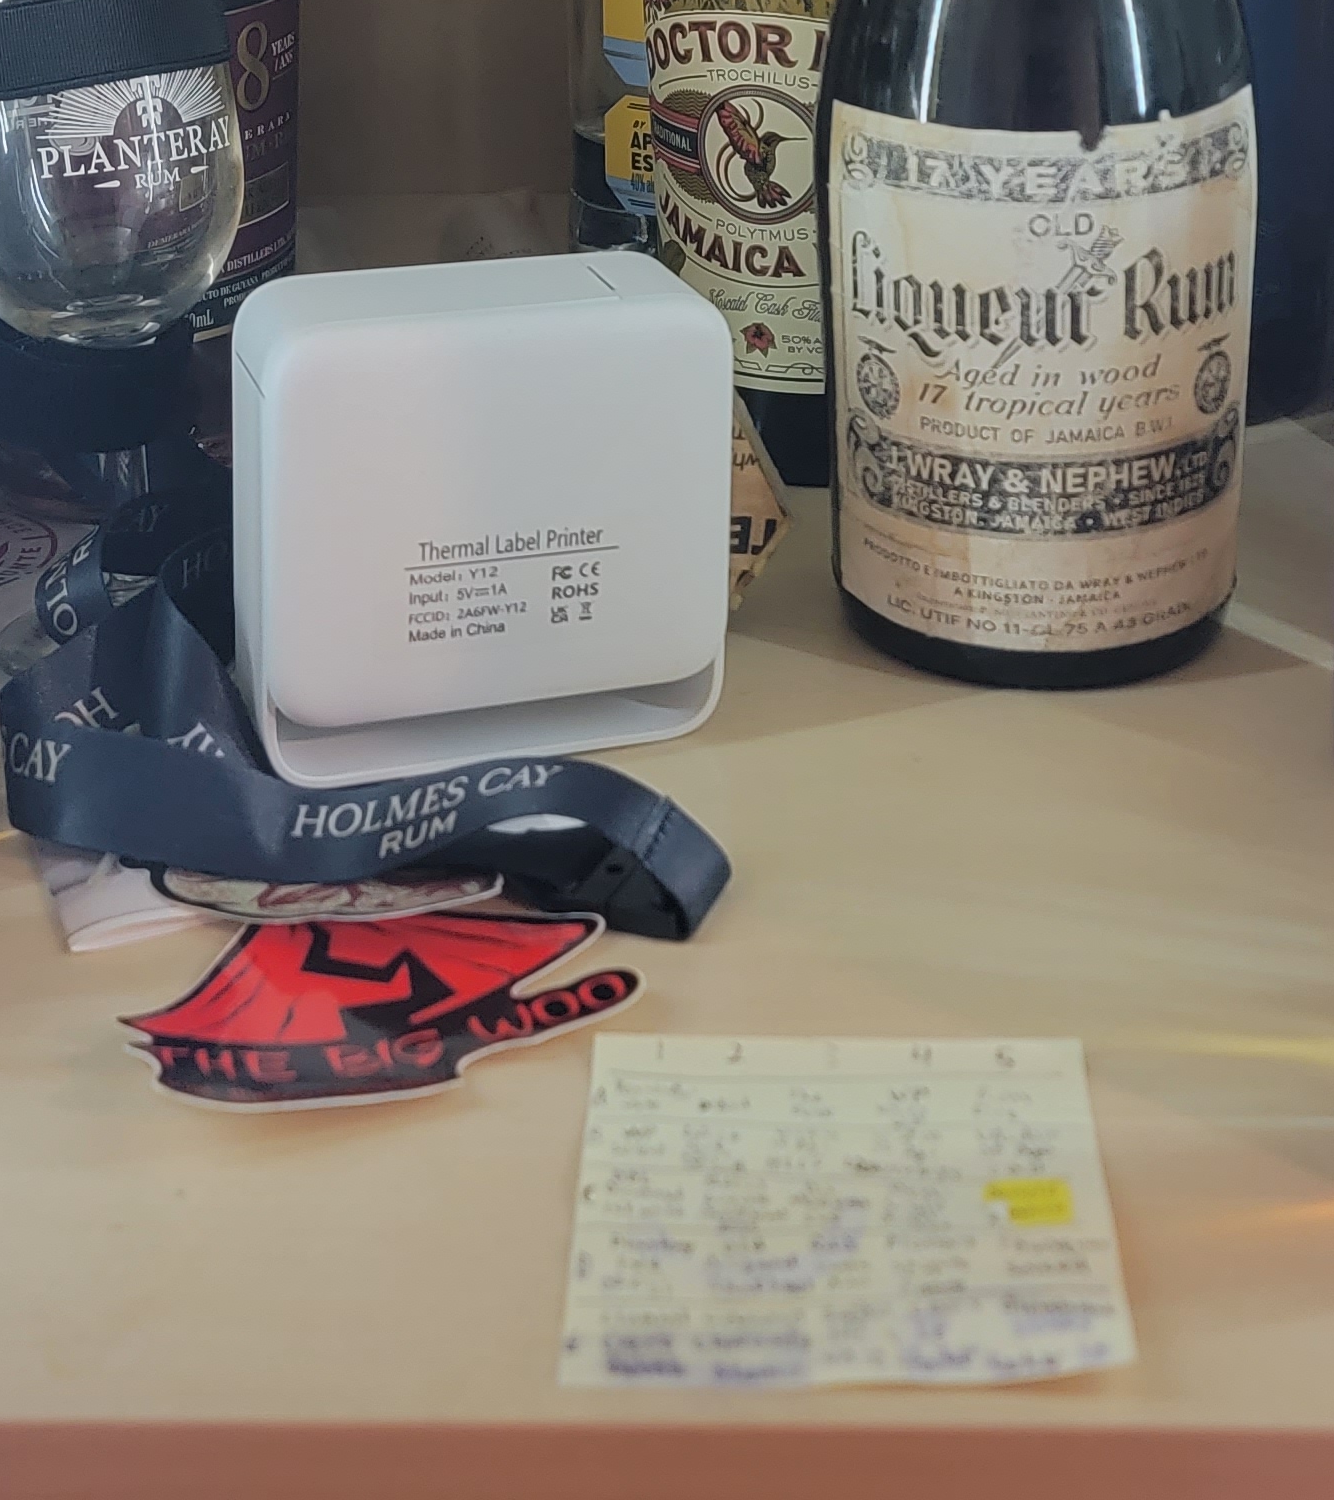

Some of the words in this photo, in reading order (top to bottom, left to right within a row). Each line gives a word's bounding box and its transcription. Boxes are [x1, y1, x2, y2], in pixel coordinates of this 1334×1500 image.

[237, 20, 270, 111] 8
[706, 68, 811, 89] TROCHILUS
[37, 115, 230, 179] PLANTERAY
[134, 166, 181, 189] RUM
[658, 194, 807, 278] JAMAICA
[715, 218, 809, 243] POLYTMUS
[1028, 212, 1095, 238] OLD
[851, 230, 1107, 358] Liqueur
[1122, 246, 1238, 341] Rum
[781, 334, 812, 345] 50%
[935, 359, 1019, 388] Aged
[1030, 361, 1061, 387] in
[1079, 353, 1162, 385] wood
[918, 383, 949, 404] 17
[965, 386, 1086, 418] tropical
[1098, 384, 1180, 421] years
[919, 416, 1002, 442] PRODUCT
[1012, 428, 1035, 443] OF
[1045, 425, 1126, 444] JAMAICA
[1004, 468, 1031, 494] &
[418, 534, 490, 562] Thermal
[495, 530, 541, 554] Label
[547, 527, 603, 549] Printer
[409, 569, 463, 587] Model:
[468, 566, 499, 580] Y12
[578, 561, 601, 578] CE
[551, 582, 599, 600] ROHS
[968, 588, 1044, 605] KINGSTON
[1054, 580, 1075, 591] DA
[408, 628, 446, 643] Made
[451, 625, 463, 638] in
[467, 622, 505, 637] China
[920, 607, 962, 626] UTIF
[967, 618, 997, 633] NO
[1064, 621, 1088, 635] 75
[9, 732, 71, 783] CAY
[290, 775, 469, 838] HOLMES
[477, 764, 564, 796] CAY
[378, 810, 458, 859] RUM
[155, 1043, 297, 1083] THE
[325, 1028, 445, 1078] BIG
[466, 972, 628, 1043] WOO
